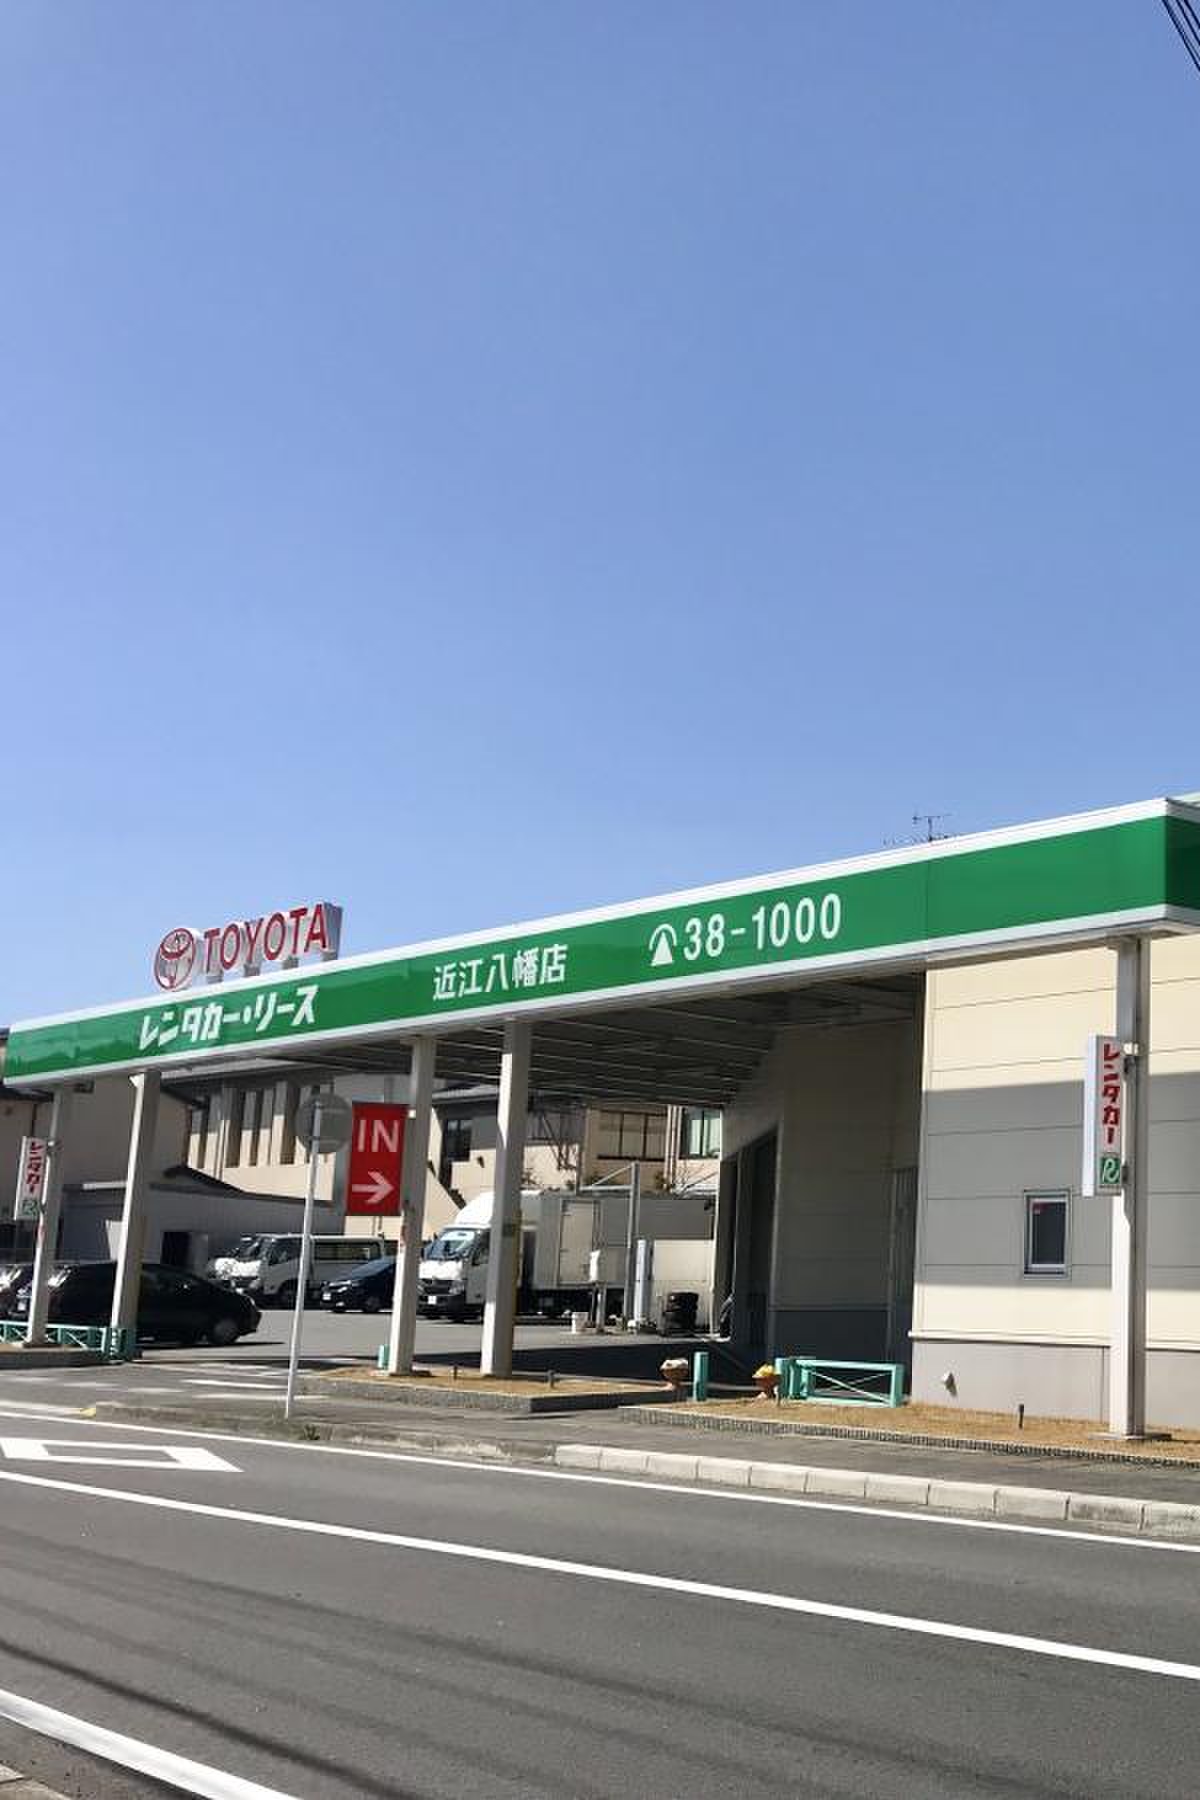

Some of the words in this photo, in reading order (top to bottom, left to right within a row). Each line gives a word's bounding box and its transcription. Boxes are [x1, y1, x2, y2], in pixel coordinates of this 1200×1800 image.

[203, 903, 327, 973] TOYOTA
[683, 893, 842, 961] 38-1000
[432, 943, 568, 1000] 近江八幡店
[1102, 1043, 1121, 1144] レンタカー
[358, 1119, 399, 1152] IN
[26, 1141, 43, 1193] レンタカー
